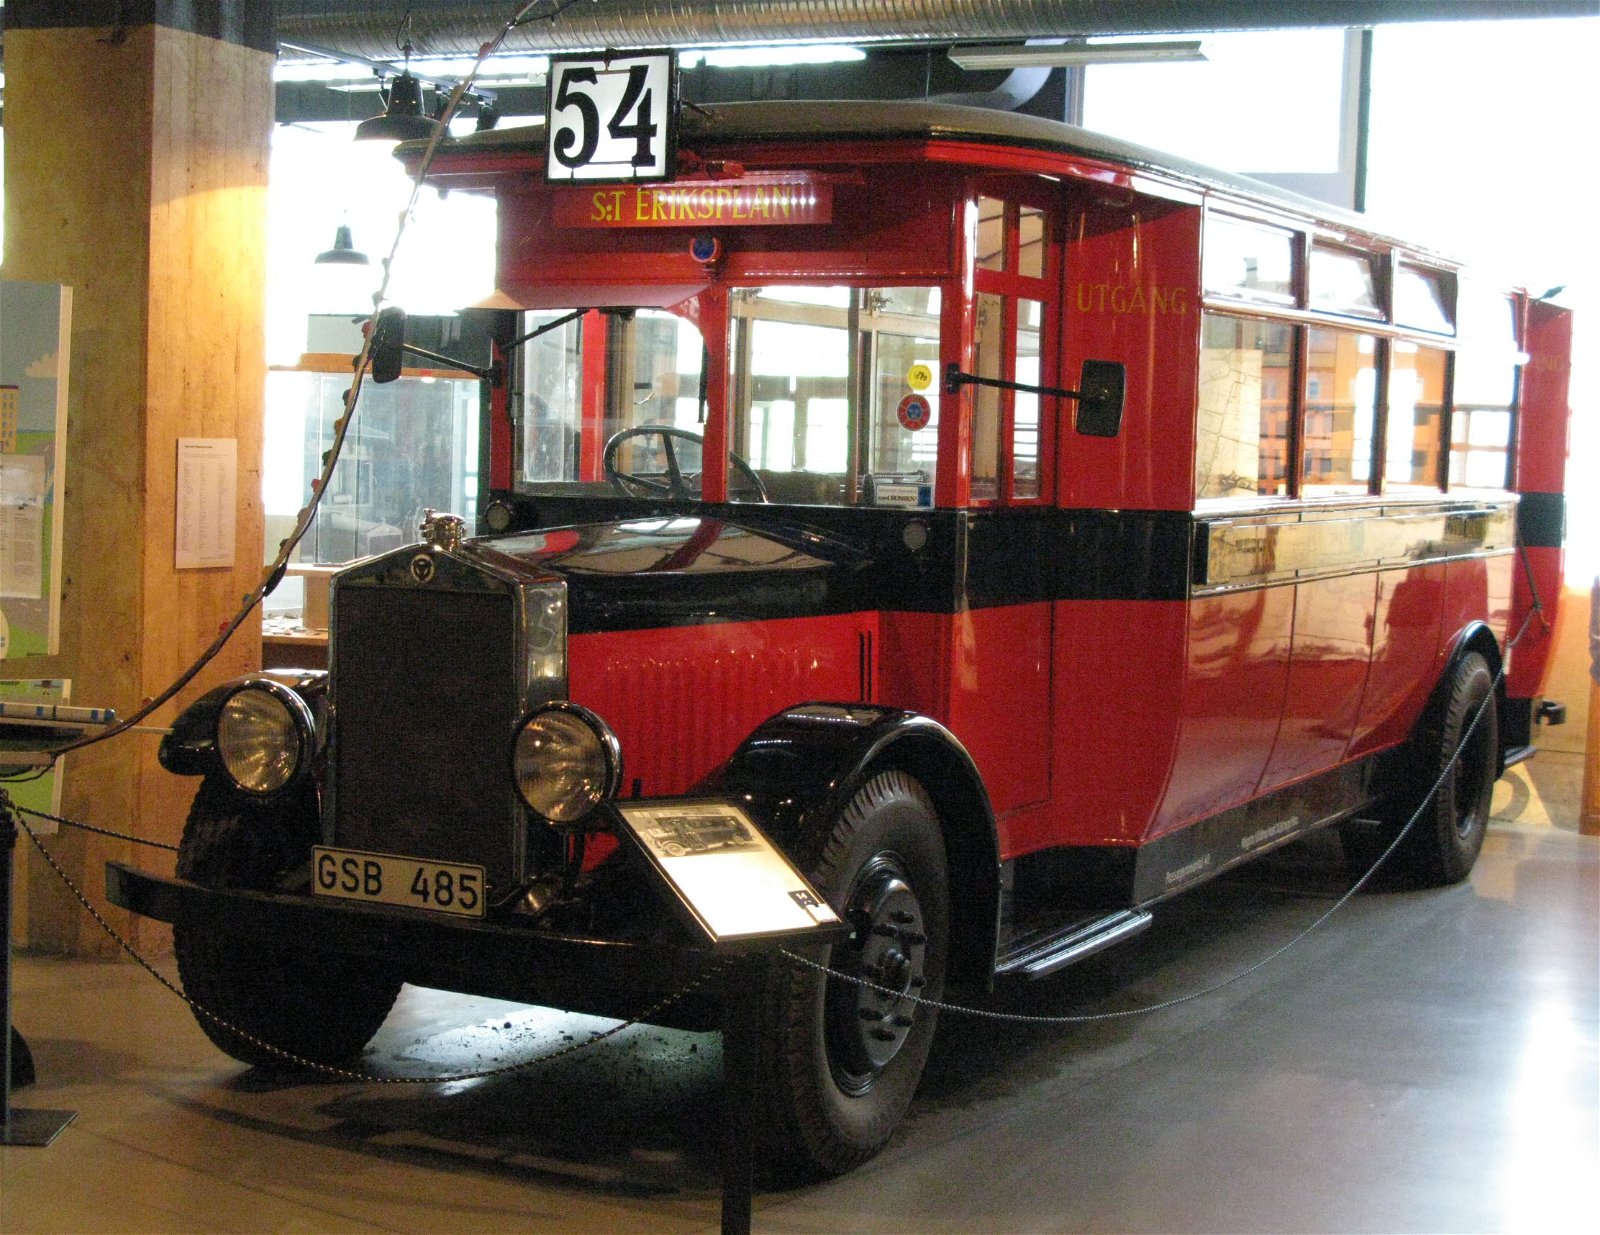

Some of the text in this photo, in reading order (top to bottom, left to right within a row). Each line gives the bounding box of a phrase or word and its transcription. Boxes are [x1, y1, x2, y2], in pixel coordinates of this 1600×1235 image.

[553, 64, 657, 169] 54
[636, 186, 792, 221] ERIKSPLAN
[1077, 281, 1189, 316] UTGÅNG
[318, 854, 478, 910] GSB 485
